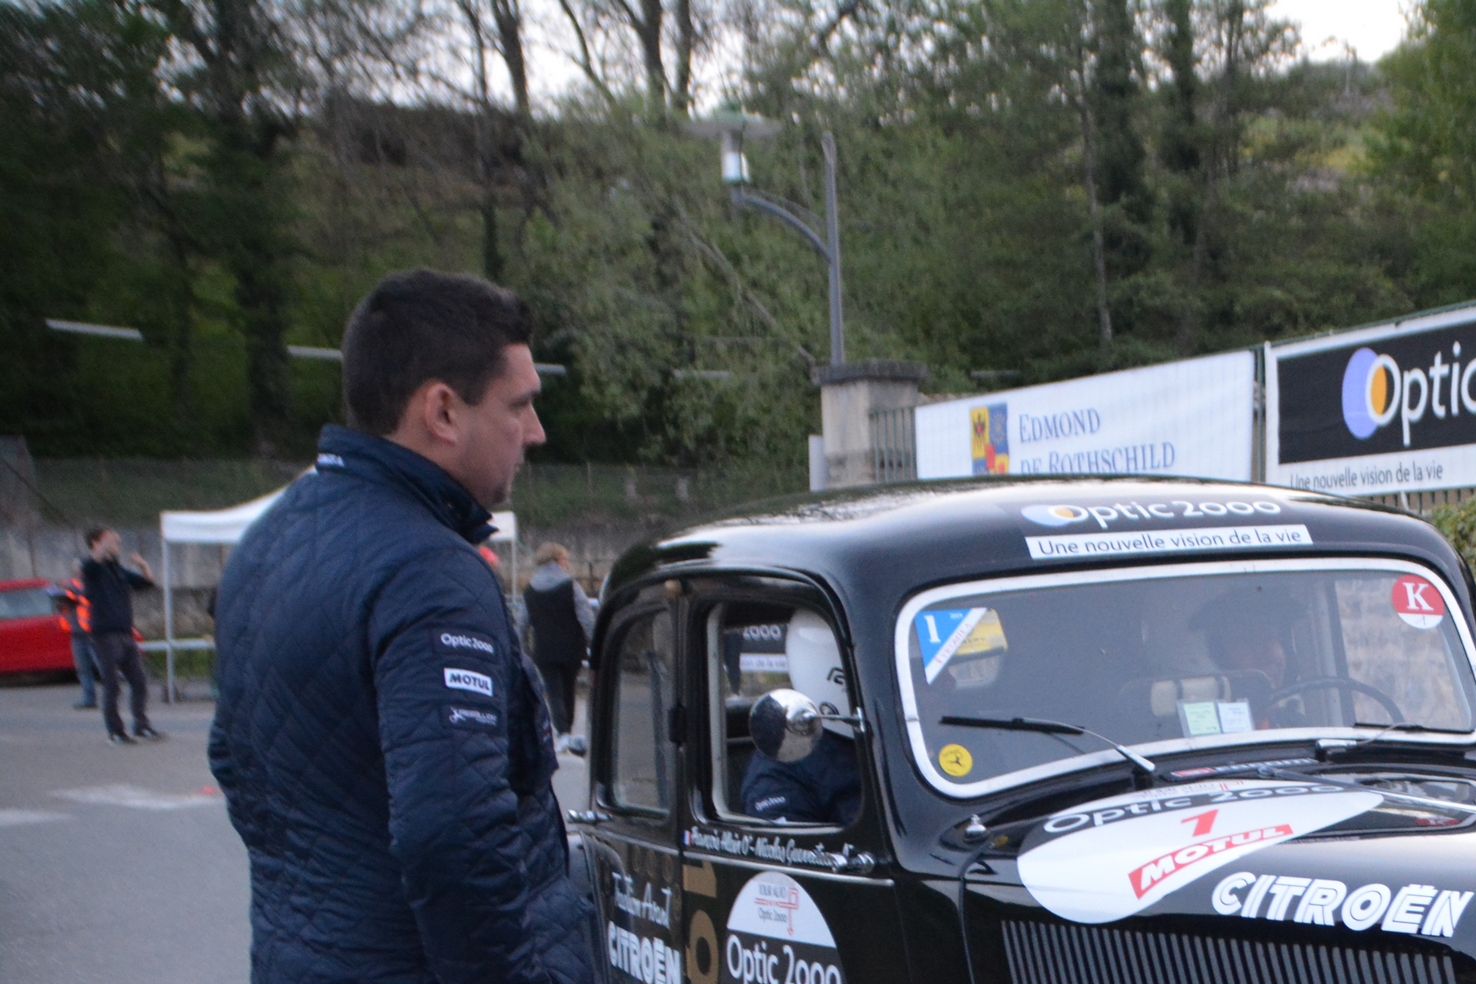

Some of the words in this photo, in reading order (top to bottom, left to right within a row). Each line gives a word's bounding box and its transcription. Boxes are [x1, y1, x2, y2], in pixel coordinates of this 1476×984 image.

[1018, 407, 1101, 443] EDMOND
[1050, 441, 1175, 475] ROTHSCHILD
[1312, 465, 1358, 490] nouvelle
[1360, 465, 1393, 487] vision
[1396, 463, 1410, 484] de
[1412, 462, 1423, 483] la
[1424, 463, 1443, 481] vie
[1048, 500, 1174, 529] Optic
[1173, 500, 1281, 518] 2000
[1038, 539, 1080, 556] Une
[1084, 533, 1166, 553] nouvelle
[1170, 530, 1224, 549] vision
[1228, 528, 1251, 545] de
[1254, 528, 1272, 543] la
[1275, 529, 1301, 543] vie
[1402, 582, 1435, 612] K
[441, 632, 472, 649] Optic
[449, 673, 491, 691] MOTUL
[1044, 797, 1192, 834] Optic
[1209, 785, 1345, 804] 2000
[1181, 809, 1219, 837] 1
[1138, 827, 1287, 895] MOTUL
[1212, 871, 1474, 938] CITROËN
